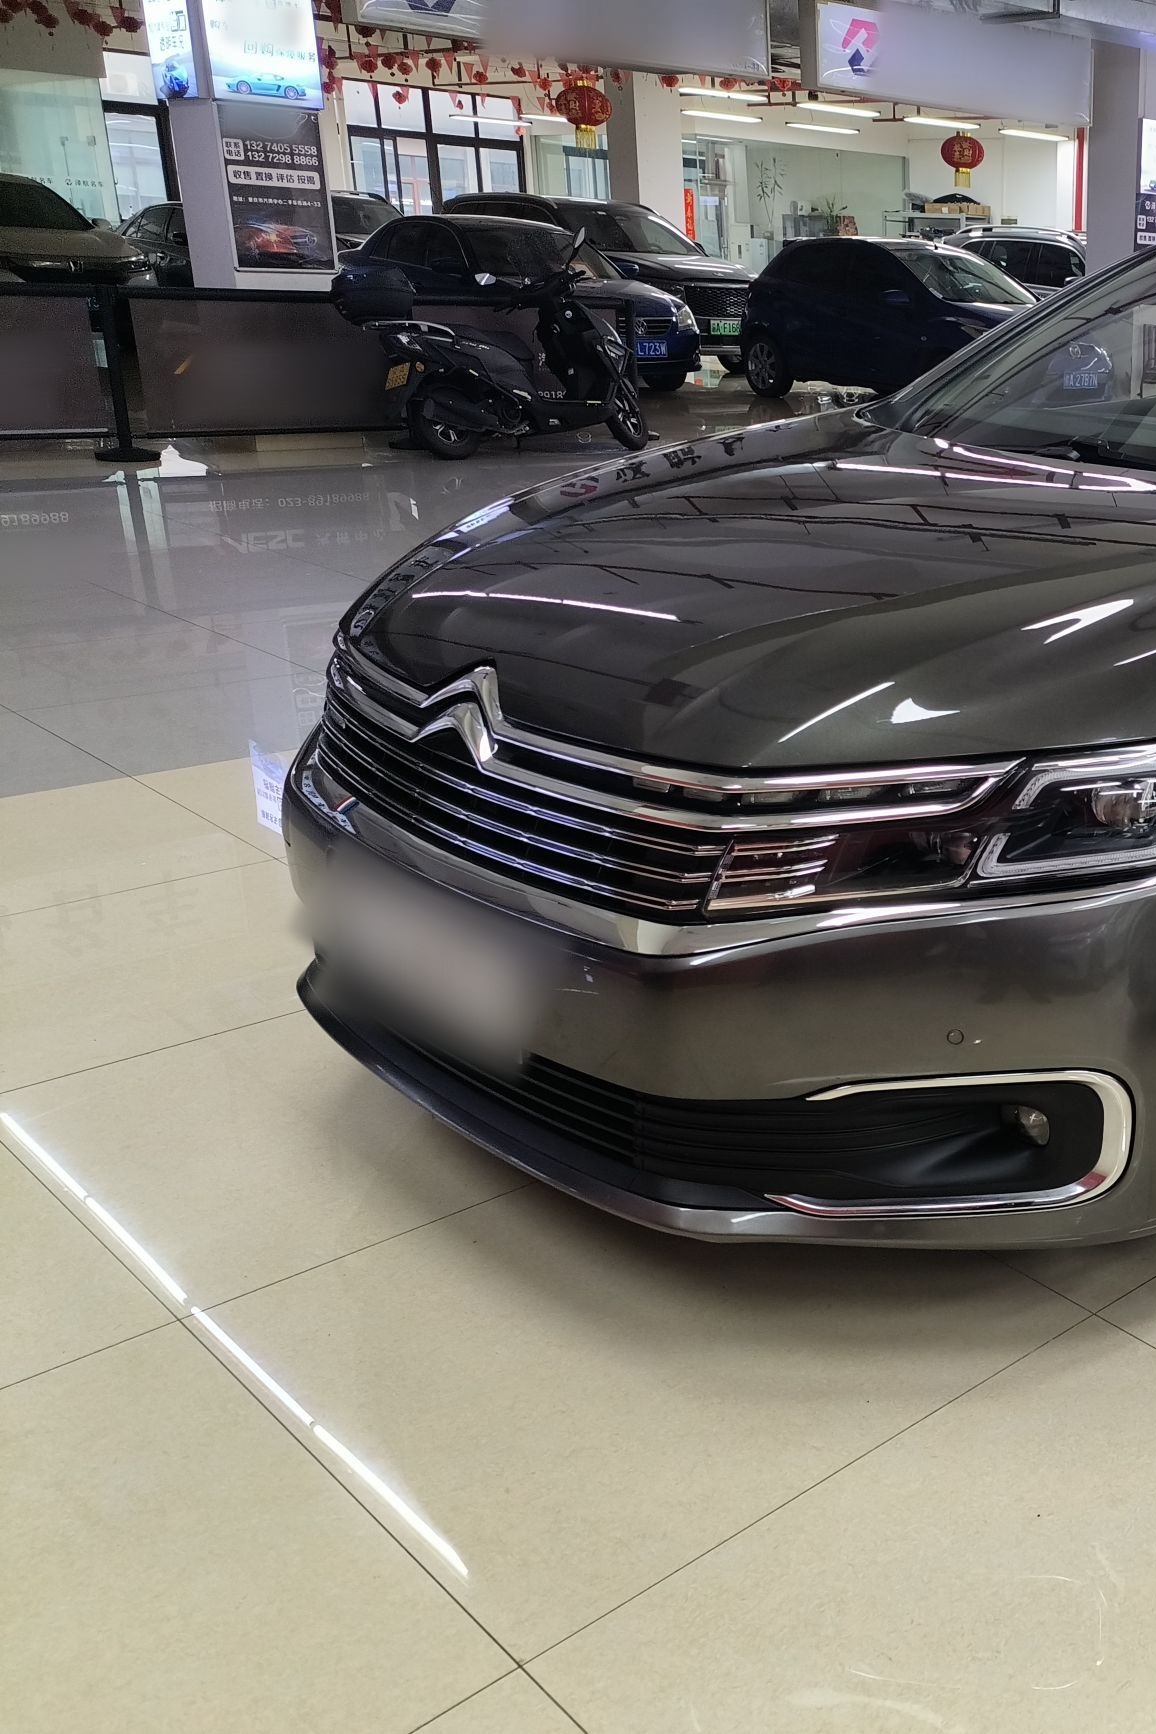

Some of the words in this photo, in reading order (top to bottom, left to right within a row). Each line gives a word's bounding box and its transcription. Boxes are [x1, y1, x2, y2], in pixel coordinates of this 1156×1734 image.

[226, 149, 242, 157] 电话
[245, 141, 263, 150] 132
[265, 142, 291, 152] 7405
[292, 145, 317, 156] 5558
[247, 152, 265, 162] 132
[267, 154, 292, 164] 7298
[294, 156, 319, 166] 8866
[255, 171, 274, 182] 置换
[276, 173, 295, 183] 评估
